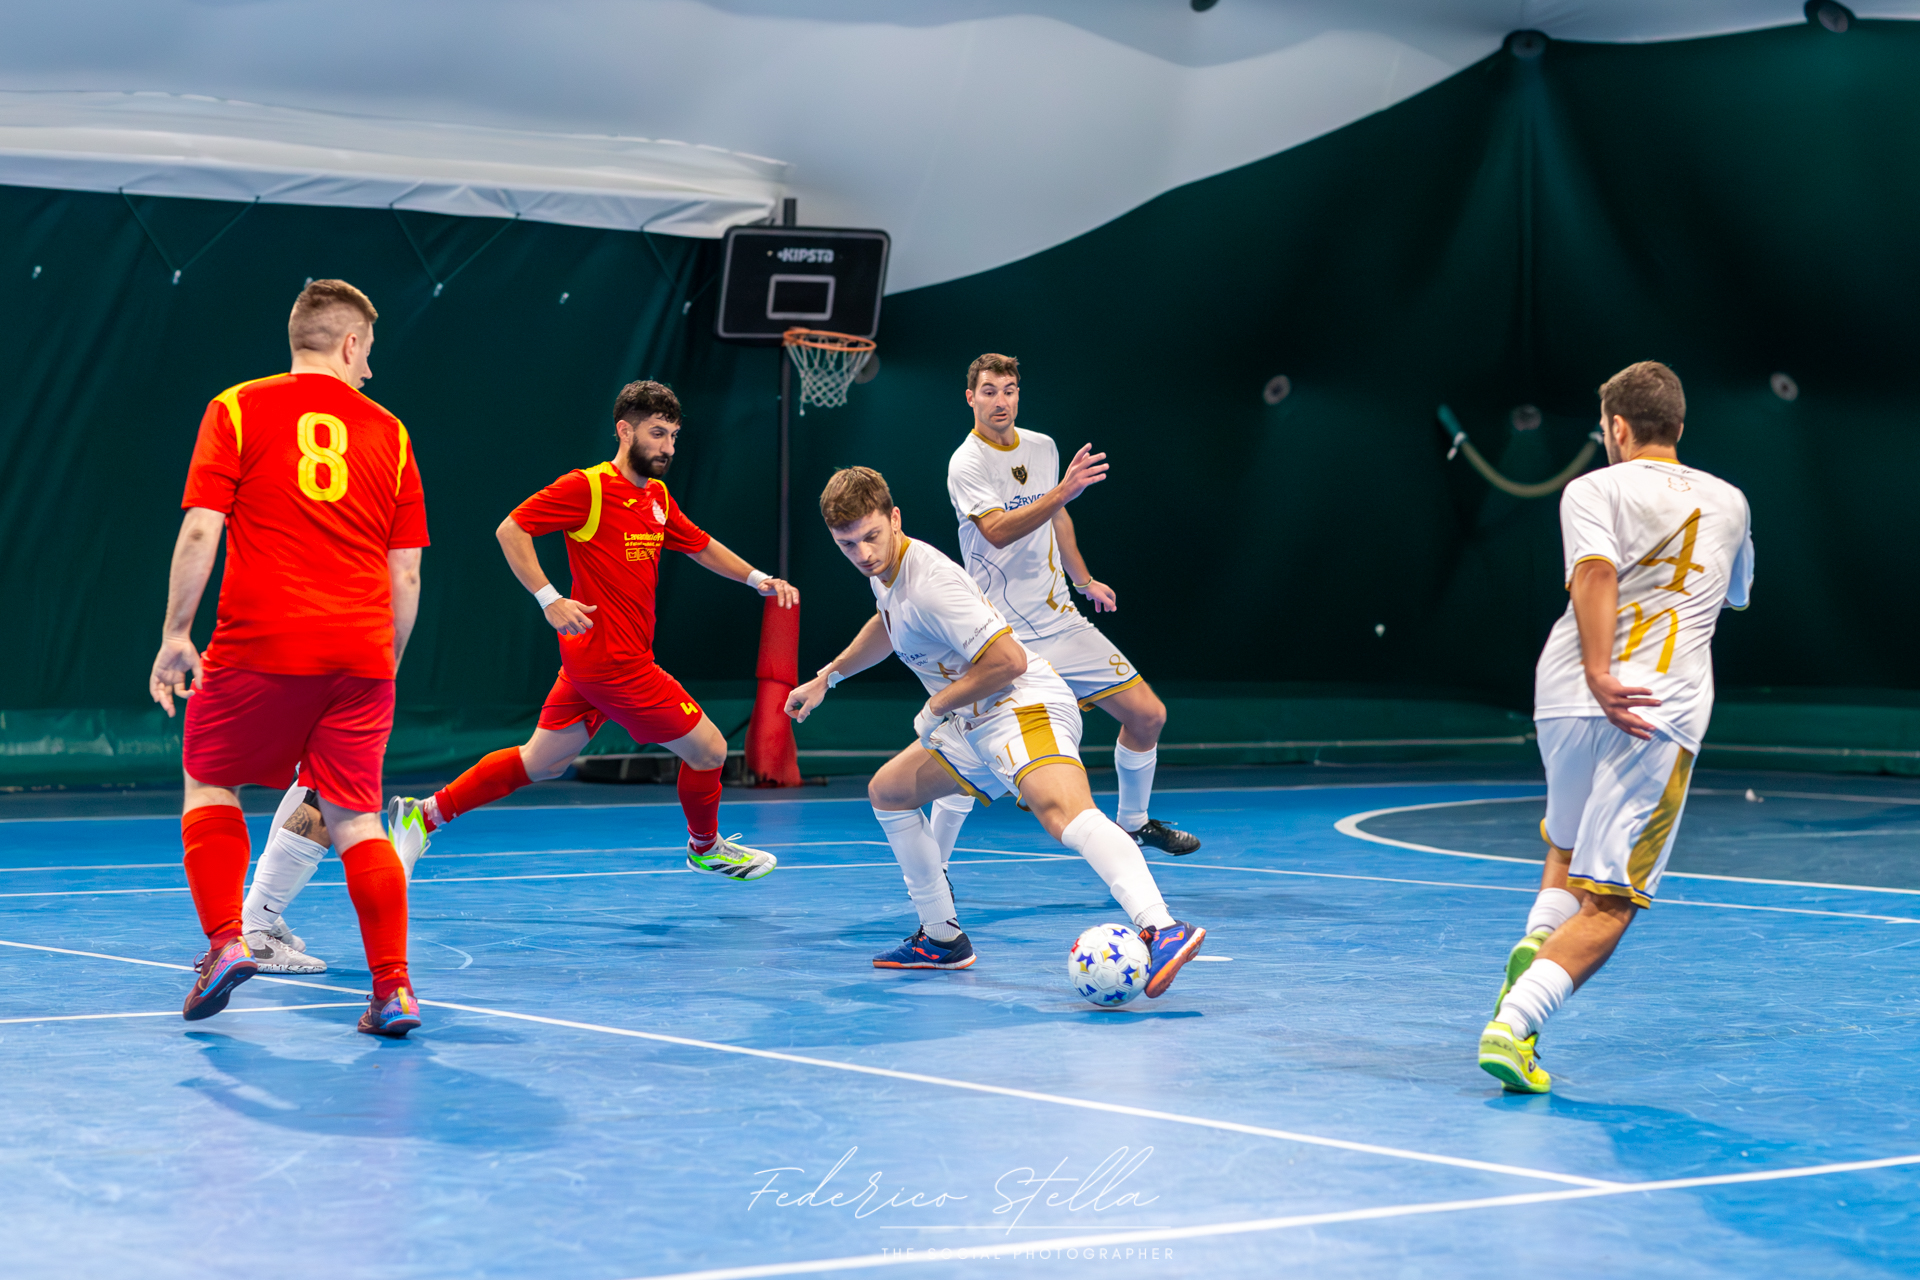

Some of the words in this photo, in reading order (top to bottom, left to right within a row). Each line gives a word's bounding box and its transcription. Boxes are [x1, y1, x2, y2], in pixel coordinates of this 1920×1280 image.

[297, 412, 348, 502] 8
[1636, 507, 1705, 596] 4
[1109, 653, 1130, 677] 8
[680, 701, 698, 716] 4
